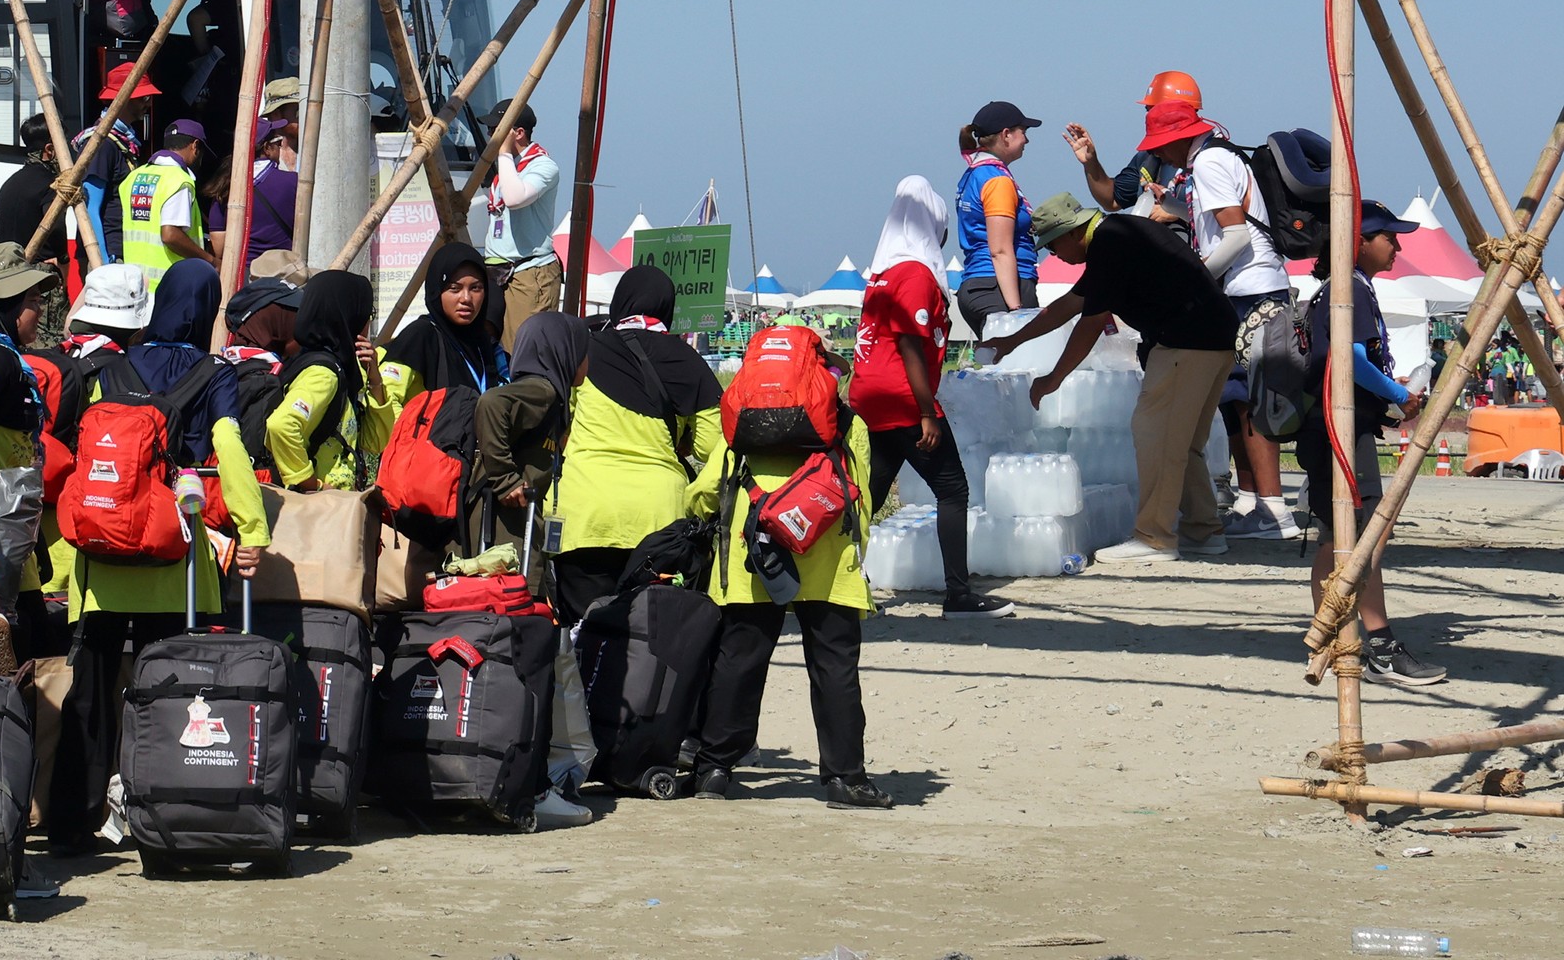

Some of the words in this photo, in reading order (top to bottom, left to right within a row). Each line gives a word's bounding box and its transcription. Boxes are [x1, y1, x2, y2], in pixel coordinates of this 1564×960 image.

[136, 174, 159, 184] SAFE
[662, 248, 716, 277] 아사기리
[675, 281, 714, 296] AGIRI
[188, 749, 235, 759] INDONESIA
[184, 757, 240, 767] CONTINGENT
